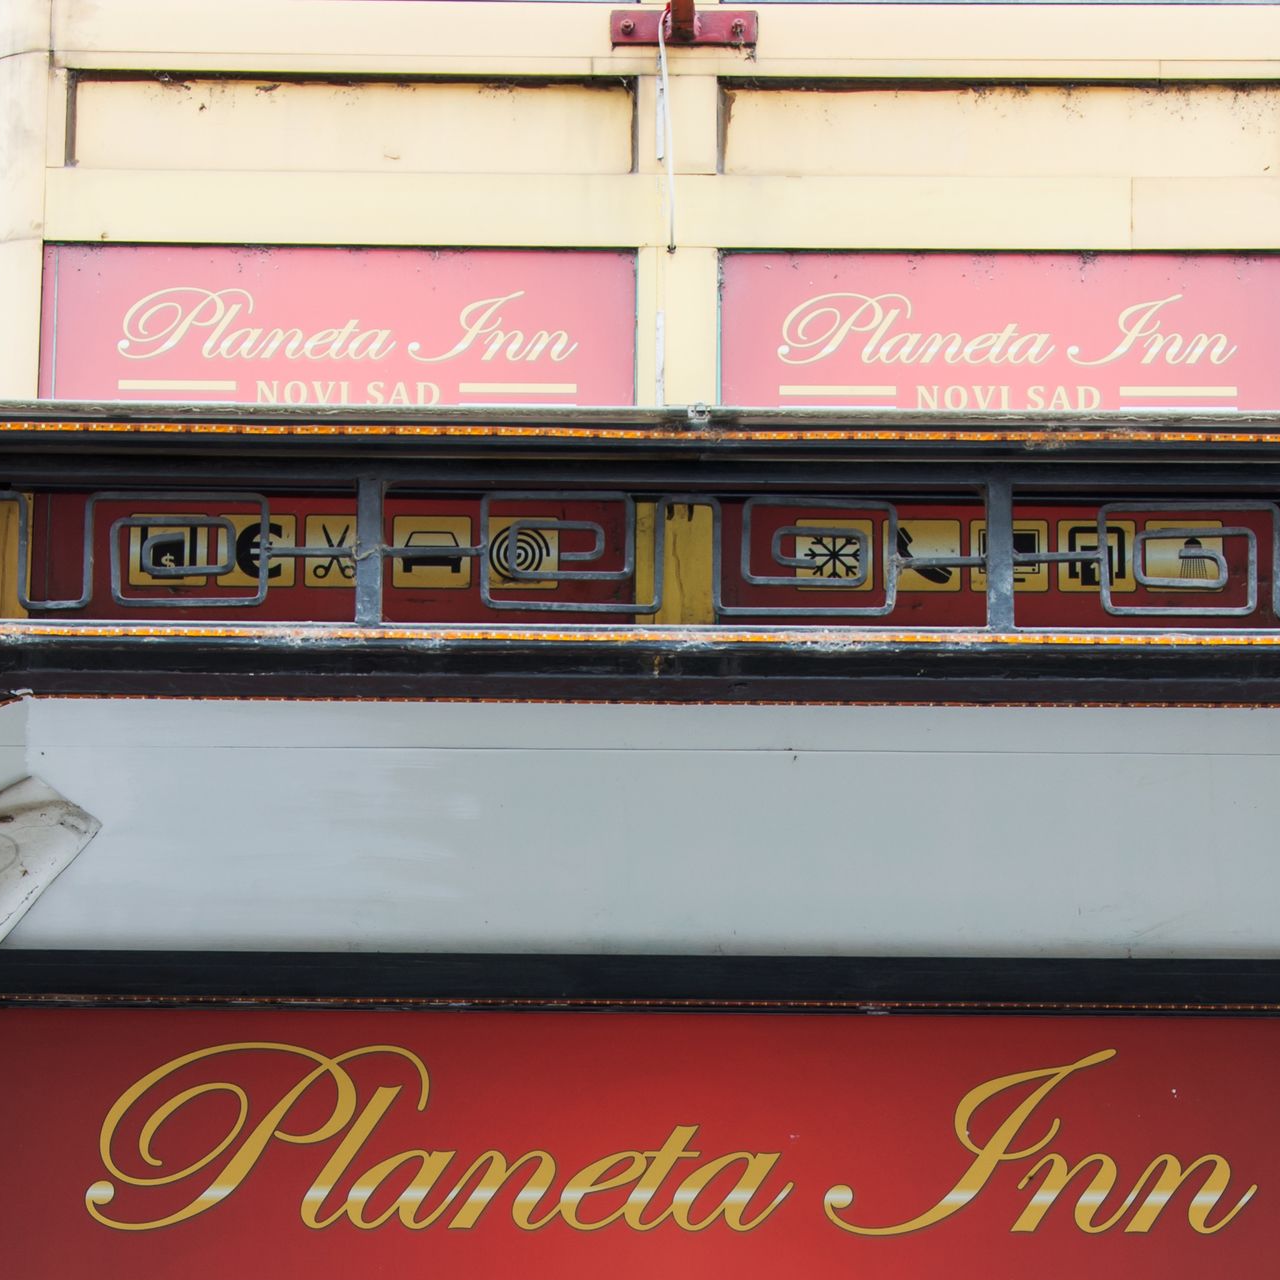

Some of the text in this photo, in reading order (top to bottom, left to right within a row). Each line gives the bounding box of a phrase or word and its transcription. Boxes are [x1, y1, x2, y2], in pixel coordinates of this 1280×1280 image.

[117, 286, 579, 362] Planeta Inn
[776, 292, 1238, 366] Planeta Inn
[255, 380, 442, 406] NOVI SAD
[916, 385, 1102, 411] NOVI SAD
[84, 1041, 1259, 1236] Planeta Inn
